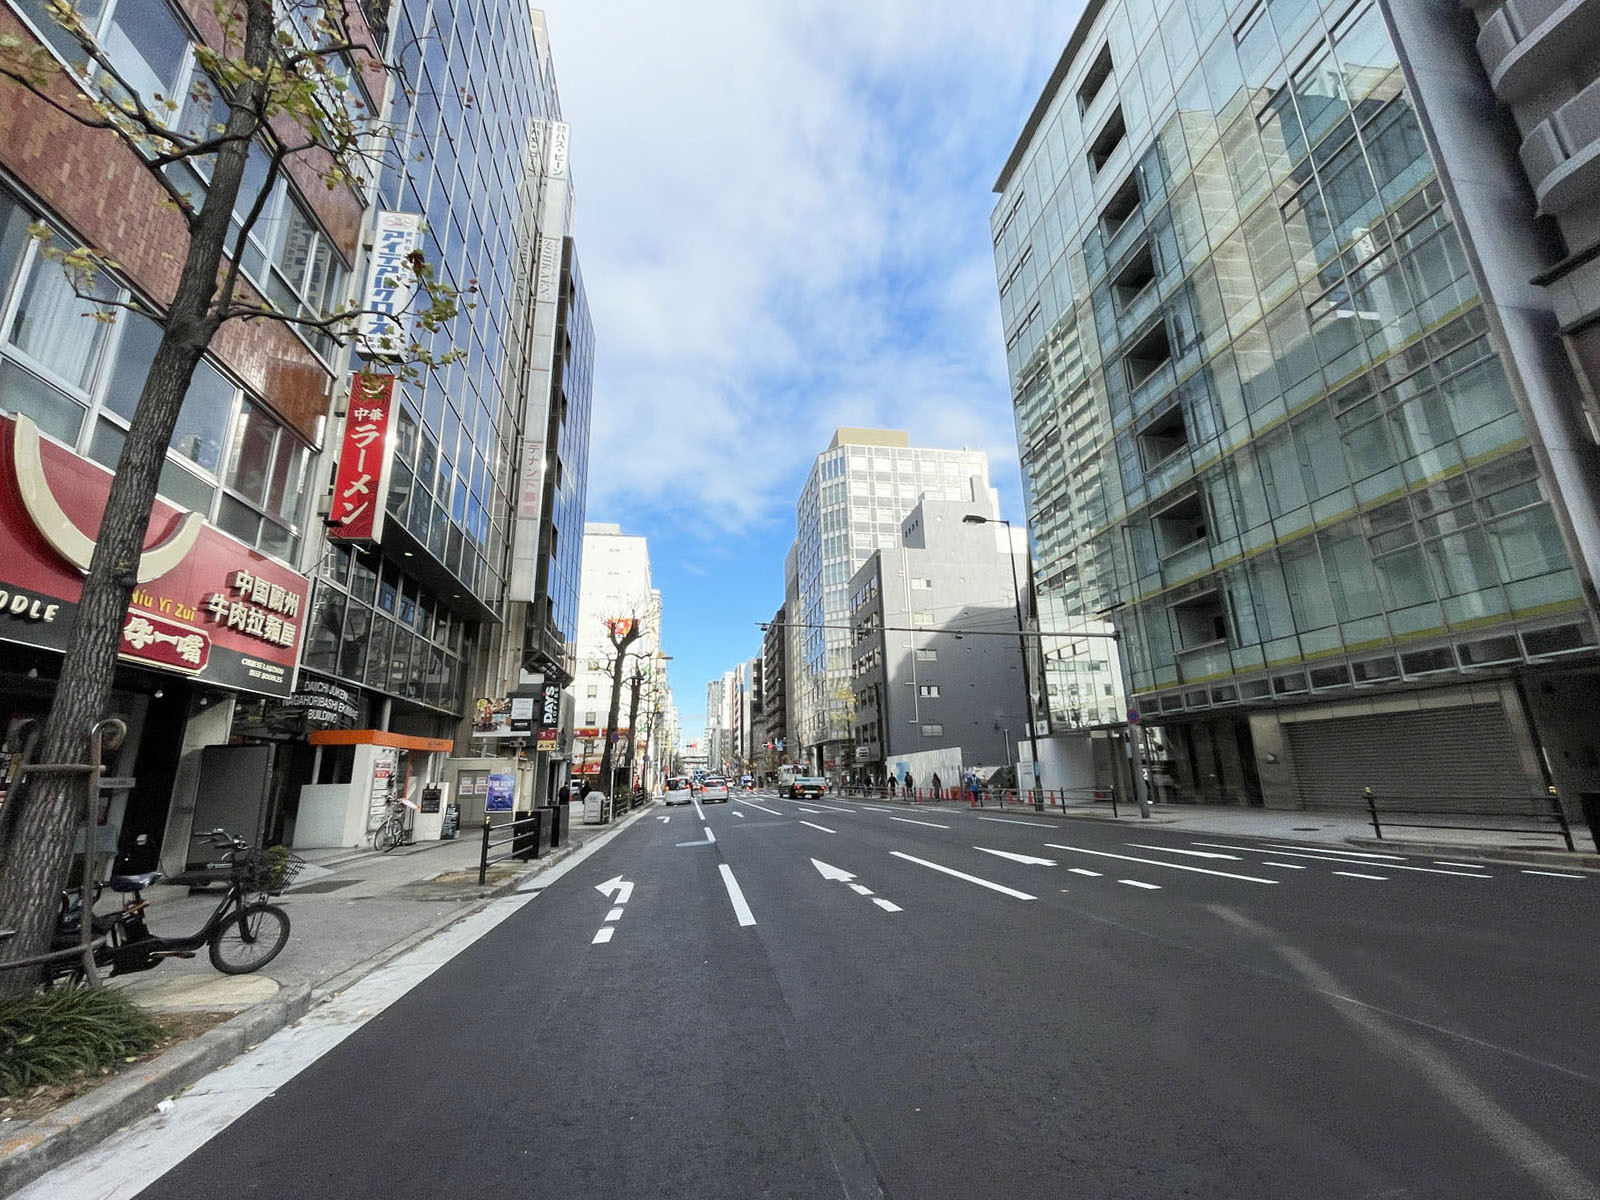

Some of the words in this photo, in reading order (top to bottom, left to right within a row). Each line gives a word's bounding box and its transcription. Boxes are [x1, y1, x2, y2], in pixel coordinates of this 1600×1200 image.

[354, 407, 384, 422] 中華
[341, 423, 380, 525] ラーメン
[307, 709, 337, 723] BUILDING
